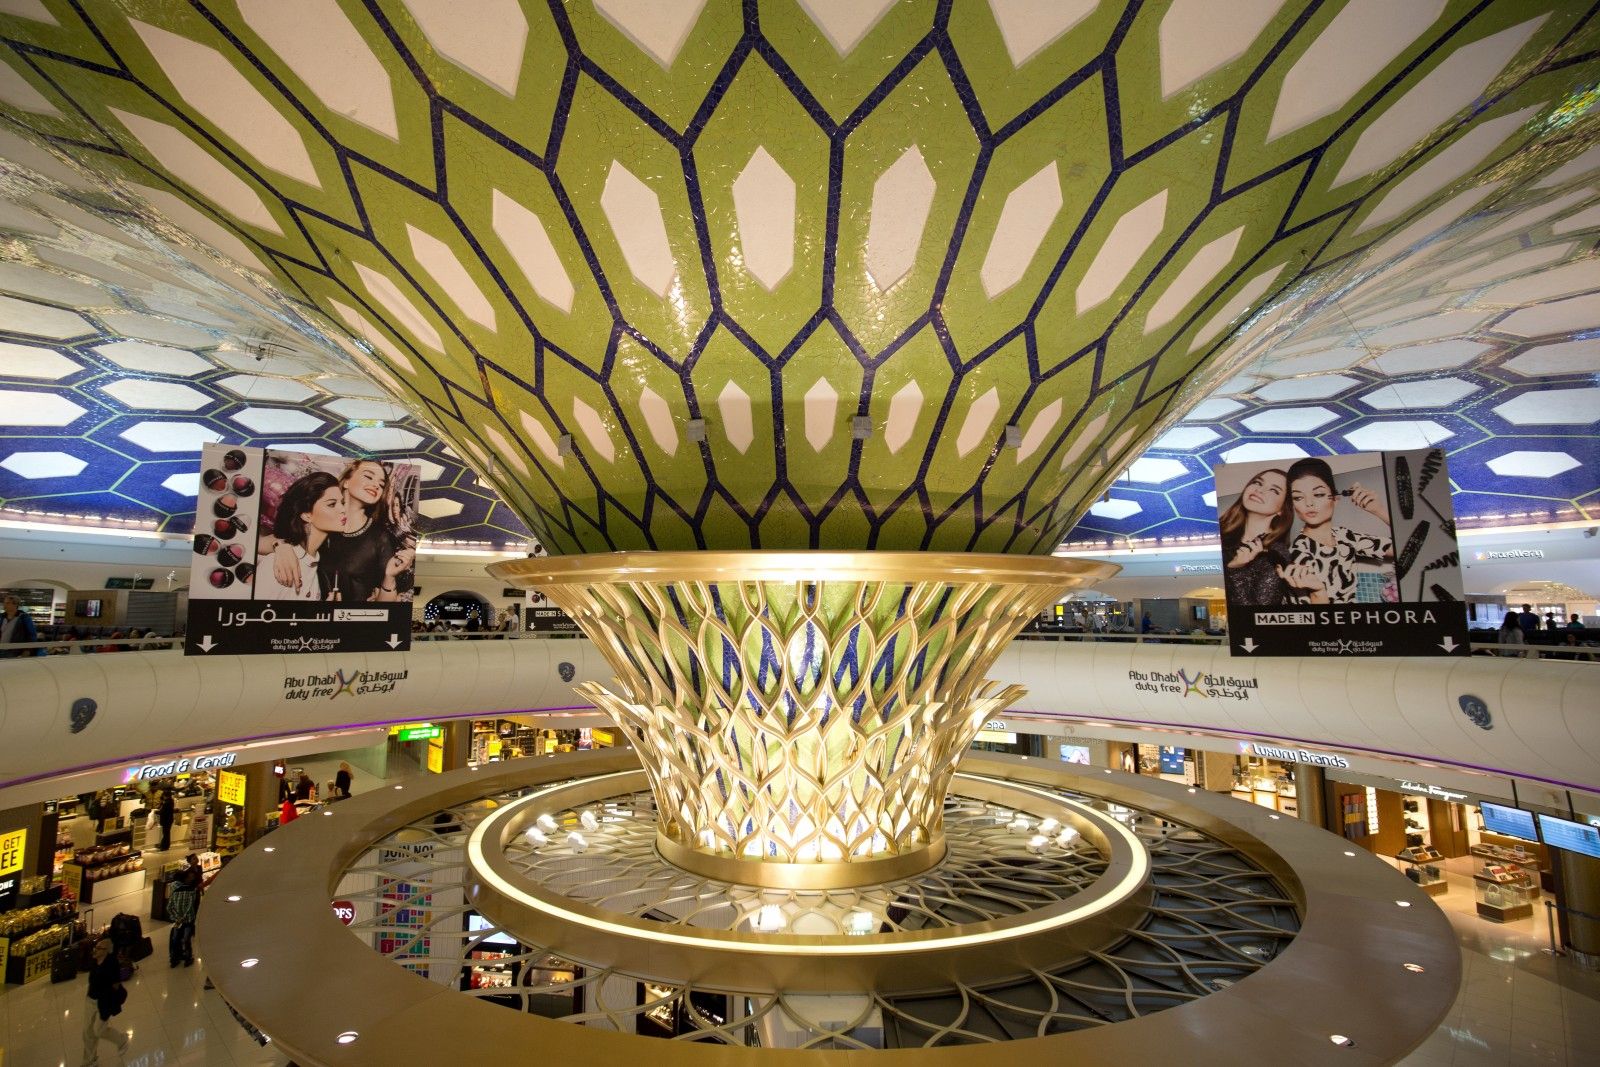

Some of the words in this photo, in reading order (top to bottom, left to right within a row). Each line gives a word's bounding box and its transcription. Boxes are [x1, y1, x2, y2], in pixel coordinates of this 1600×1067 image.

[218, 604, 331, 627] سيفورا
[1257, 614, 1295, 624] MADE
[1299, 614, 1313, 624] IN
[1320, 610, 1437, 625] SEPHORA
[284, 677, 305, 688] Abu
[307, 674, 336, 687] Dhabi
[1129, 670, 1148, 680] Abu
[1151, 671, 1179, 683] Dhabi
[285, 688, 308, 700] duty
[312, 687, 333, 698] free
[1135, 682, 1158, 693] duty
[1160, 683, 1181, 693] free
[1252, 743, 1298, 763] Luxury
[1299, 749, 1348, 769] Brands
[140, 763, 176, 780] Food
[178, 760, 190, 772] &
[195, 753, 237, 770] Candy
[3, 836, 21, 850] GET
